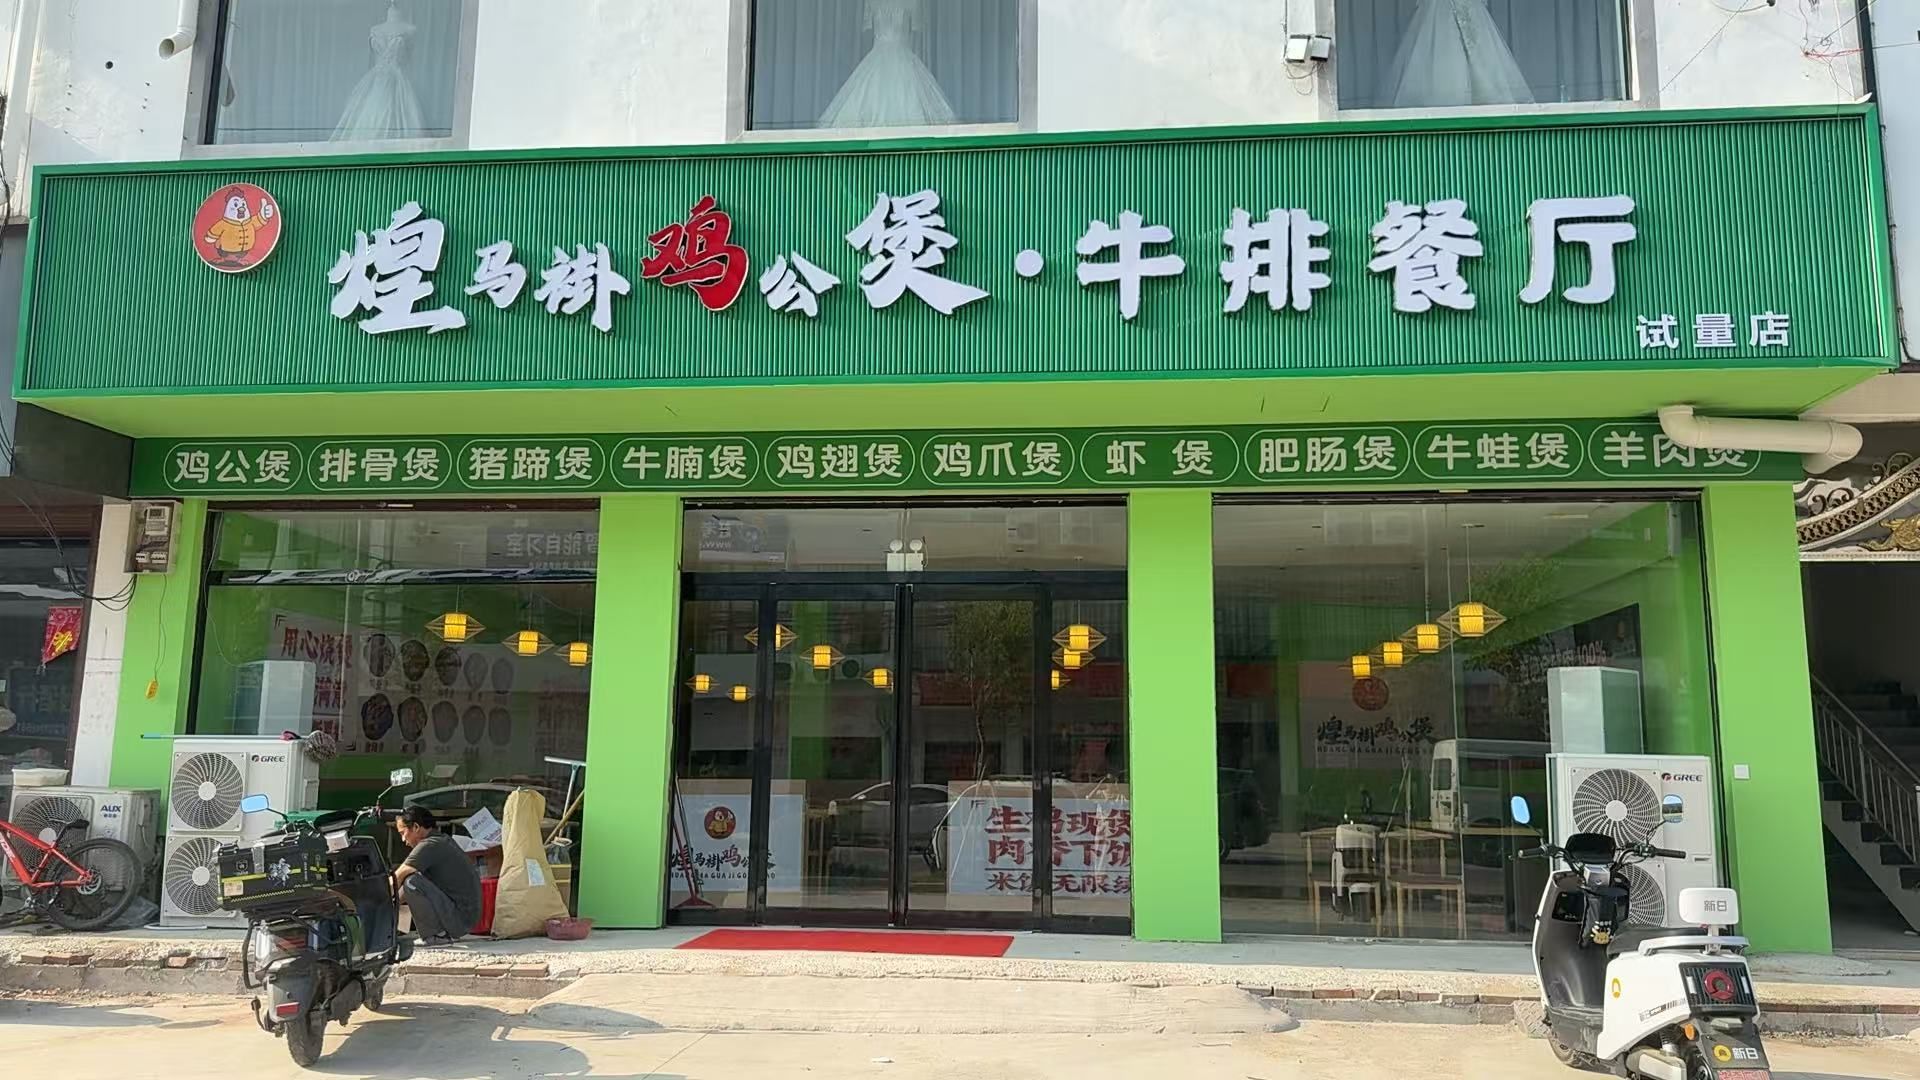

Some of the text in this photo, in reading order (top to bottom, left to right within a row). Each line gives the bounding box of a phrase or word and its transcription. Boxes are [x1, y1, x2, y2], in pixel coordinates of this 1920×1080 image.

[1636, 311, 1791, 349] 试量店
[174, 449, 291, 483] 鸡公煲
[319, 447, 440, 481] 排骨煲
[470, 446, 593, 482] 猪蹄煲
[622, 444, 748, 480] 牛腩煲
[776, 443, 903, 480] 鸡翅煲
[933, 441, 1061, 479] 鸡爪煲
[1258, 437, 1397, 474] 肥肠煲
[1427, 434, 1571, 471] 牛蛙煲
[1673, 773, 1703, 781] GREE
[100, 804, 122, 812] AUX
[1703, 900, 1728, 912] 新日
[1733, 1047, 1759, 1060] 新日
